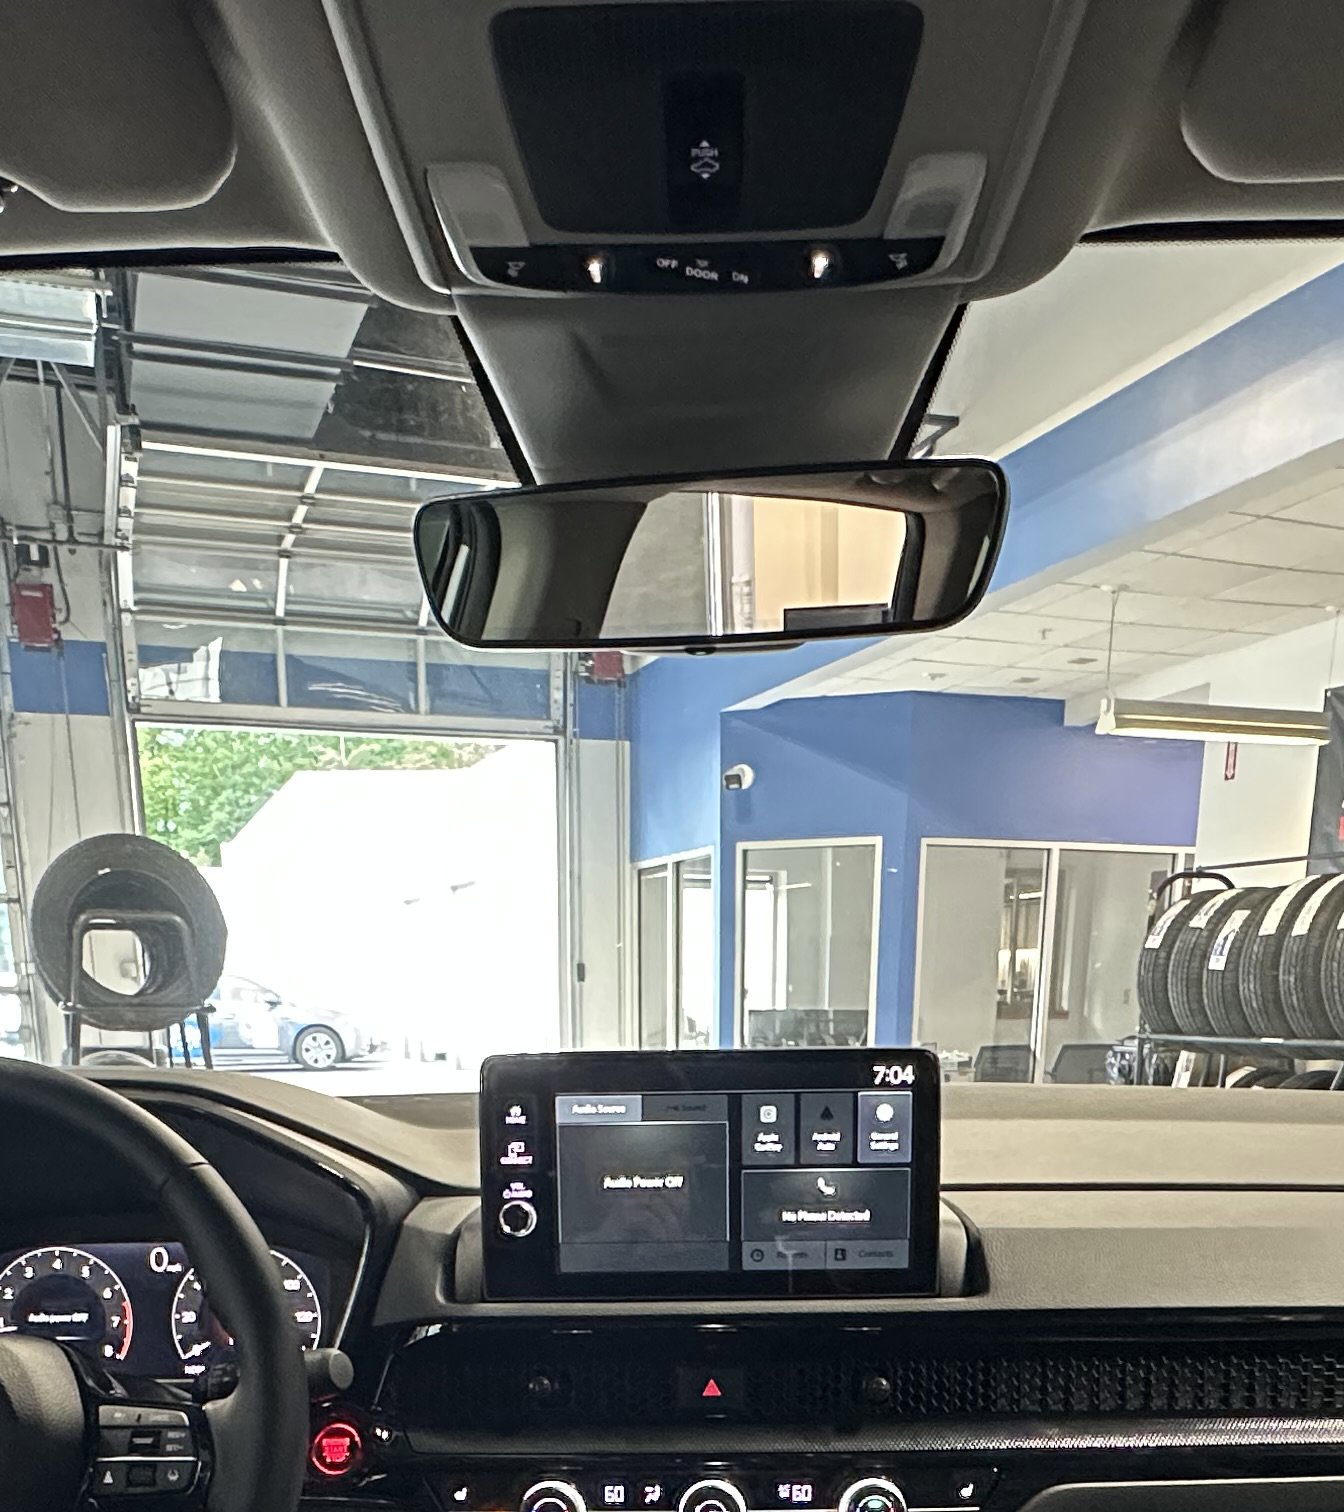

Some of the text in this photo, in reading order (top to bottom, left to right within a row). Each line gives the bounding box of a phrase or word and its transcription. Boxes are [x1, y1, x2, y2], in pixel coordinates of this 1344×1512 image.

[656, 258, 678, 269] OFF
[685, 266, 719, 281] DOOR
[873, 1065, 915, 1085] 7:04
[572, 1104, 626, 1114] Audio Source
[603, 1175, 632, 1189] Audio
[633, 1175, 664, 1188] Power
[798, 1209, 827, 1222] Phone
[827, 1209, 871, 1222] Detected
[52, 1258, 63, 1270] 4
[149, 1246, 169, 1273] 0
[24, 1266, 34, 1279] 3
[81, 1265, 91, 1279] 5
[3, 1287, 15, 1300] 2
[103, 1290, 113, 1300] 6
[111, 1315, 121, 1328] 7
[181, 1311, 197, 1324] 20
[294, 1311, 313, 1323] 120
[604, 1485, 625, 1503] 60
[791, 1484, 813, 1502] 60
